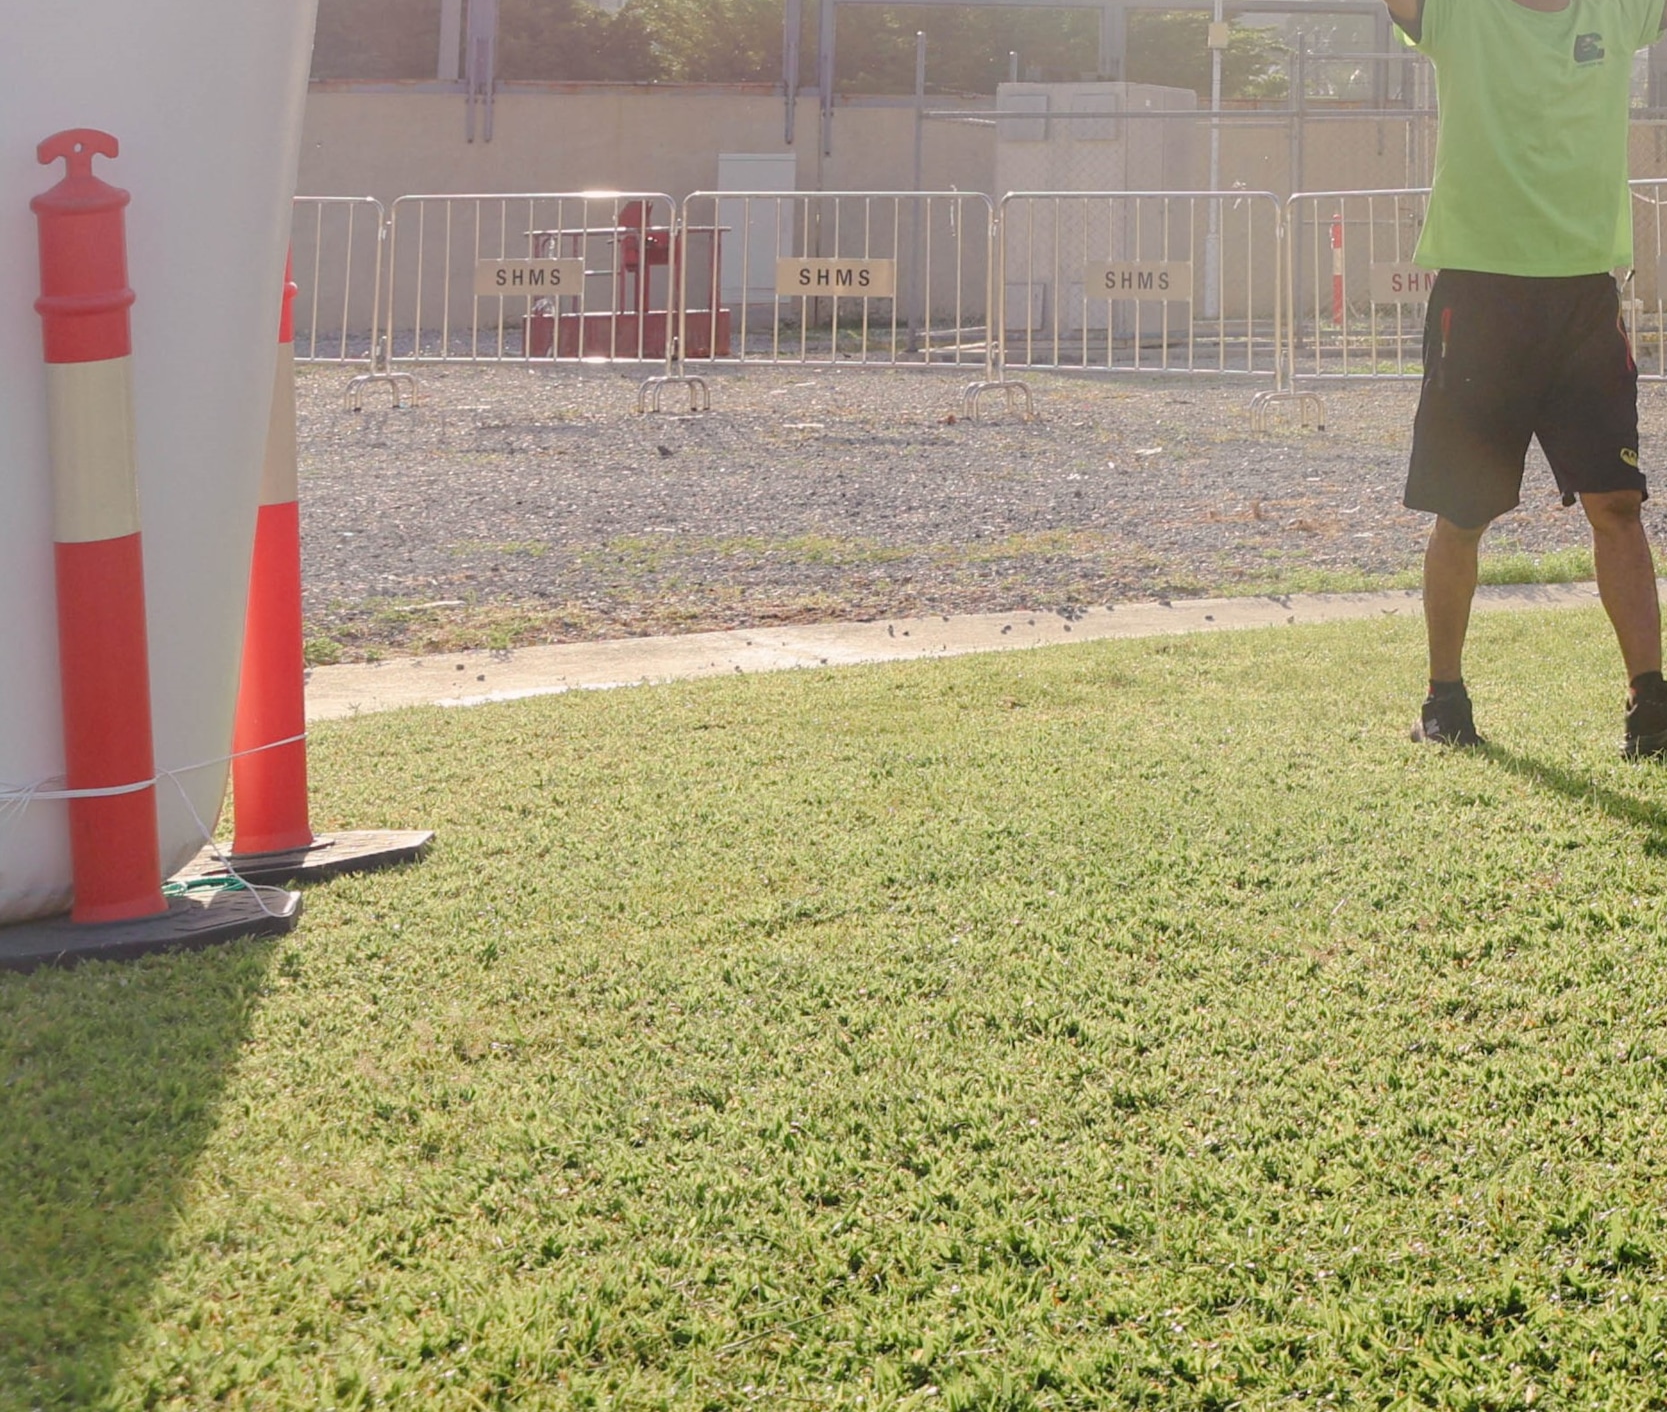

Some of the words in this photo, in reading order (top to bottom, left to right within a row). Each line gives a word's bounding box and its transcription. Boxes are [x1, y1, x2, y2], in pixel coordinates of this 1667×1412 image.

[496, 268, 561, 286] SHMS
[799, 268, 870, 287] SHMS
[1105, 270, 1169, 290] SHMS
[1392, 273, 1438, 292] SHM
